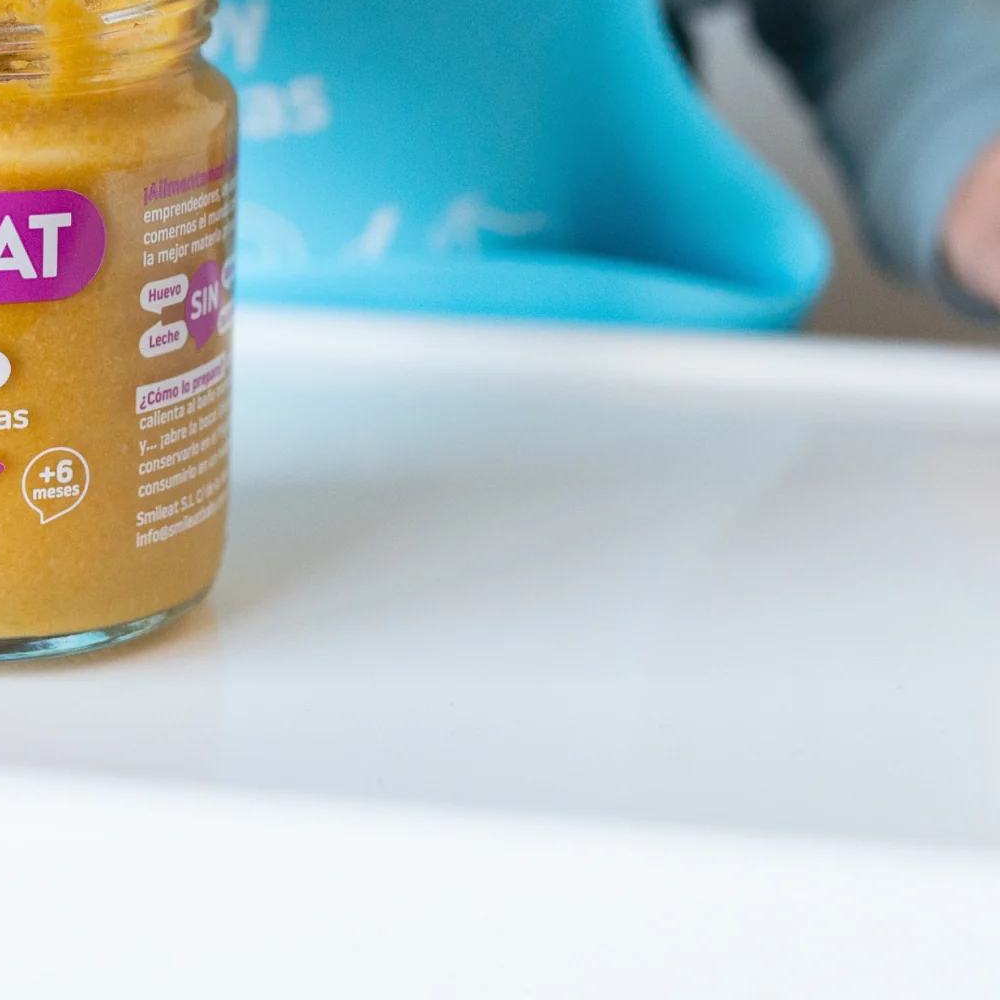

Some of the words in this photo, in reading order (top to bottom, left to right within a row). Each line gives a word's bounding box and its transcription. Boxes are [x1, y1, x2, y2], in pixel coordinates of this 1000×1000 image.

[143, 219, 197, 245] comernos
[143, 250, 154, 268] la
[157, 242, 190, 264] mejor
[148, 284, 182, 303] Huevo
[190, 280, 219, 320] SIN
[149, 329, 180, 349] Leche
[139, 386, 180, 411] ¿Cómo
[181, 379, 191, 395] lo
[139, 404, 185, 431] calienta
[186, 397, 196, 415] al
[138, 439, 158, 457] y...
[160, 427, 188, 450] ¡abre
[39, 459, 74, 484] +6
[32, 484, 80, 500] meses
[136, 500, 179, 528] Smileat
